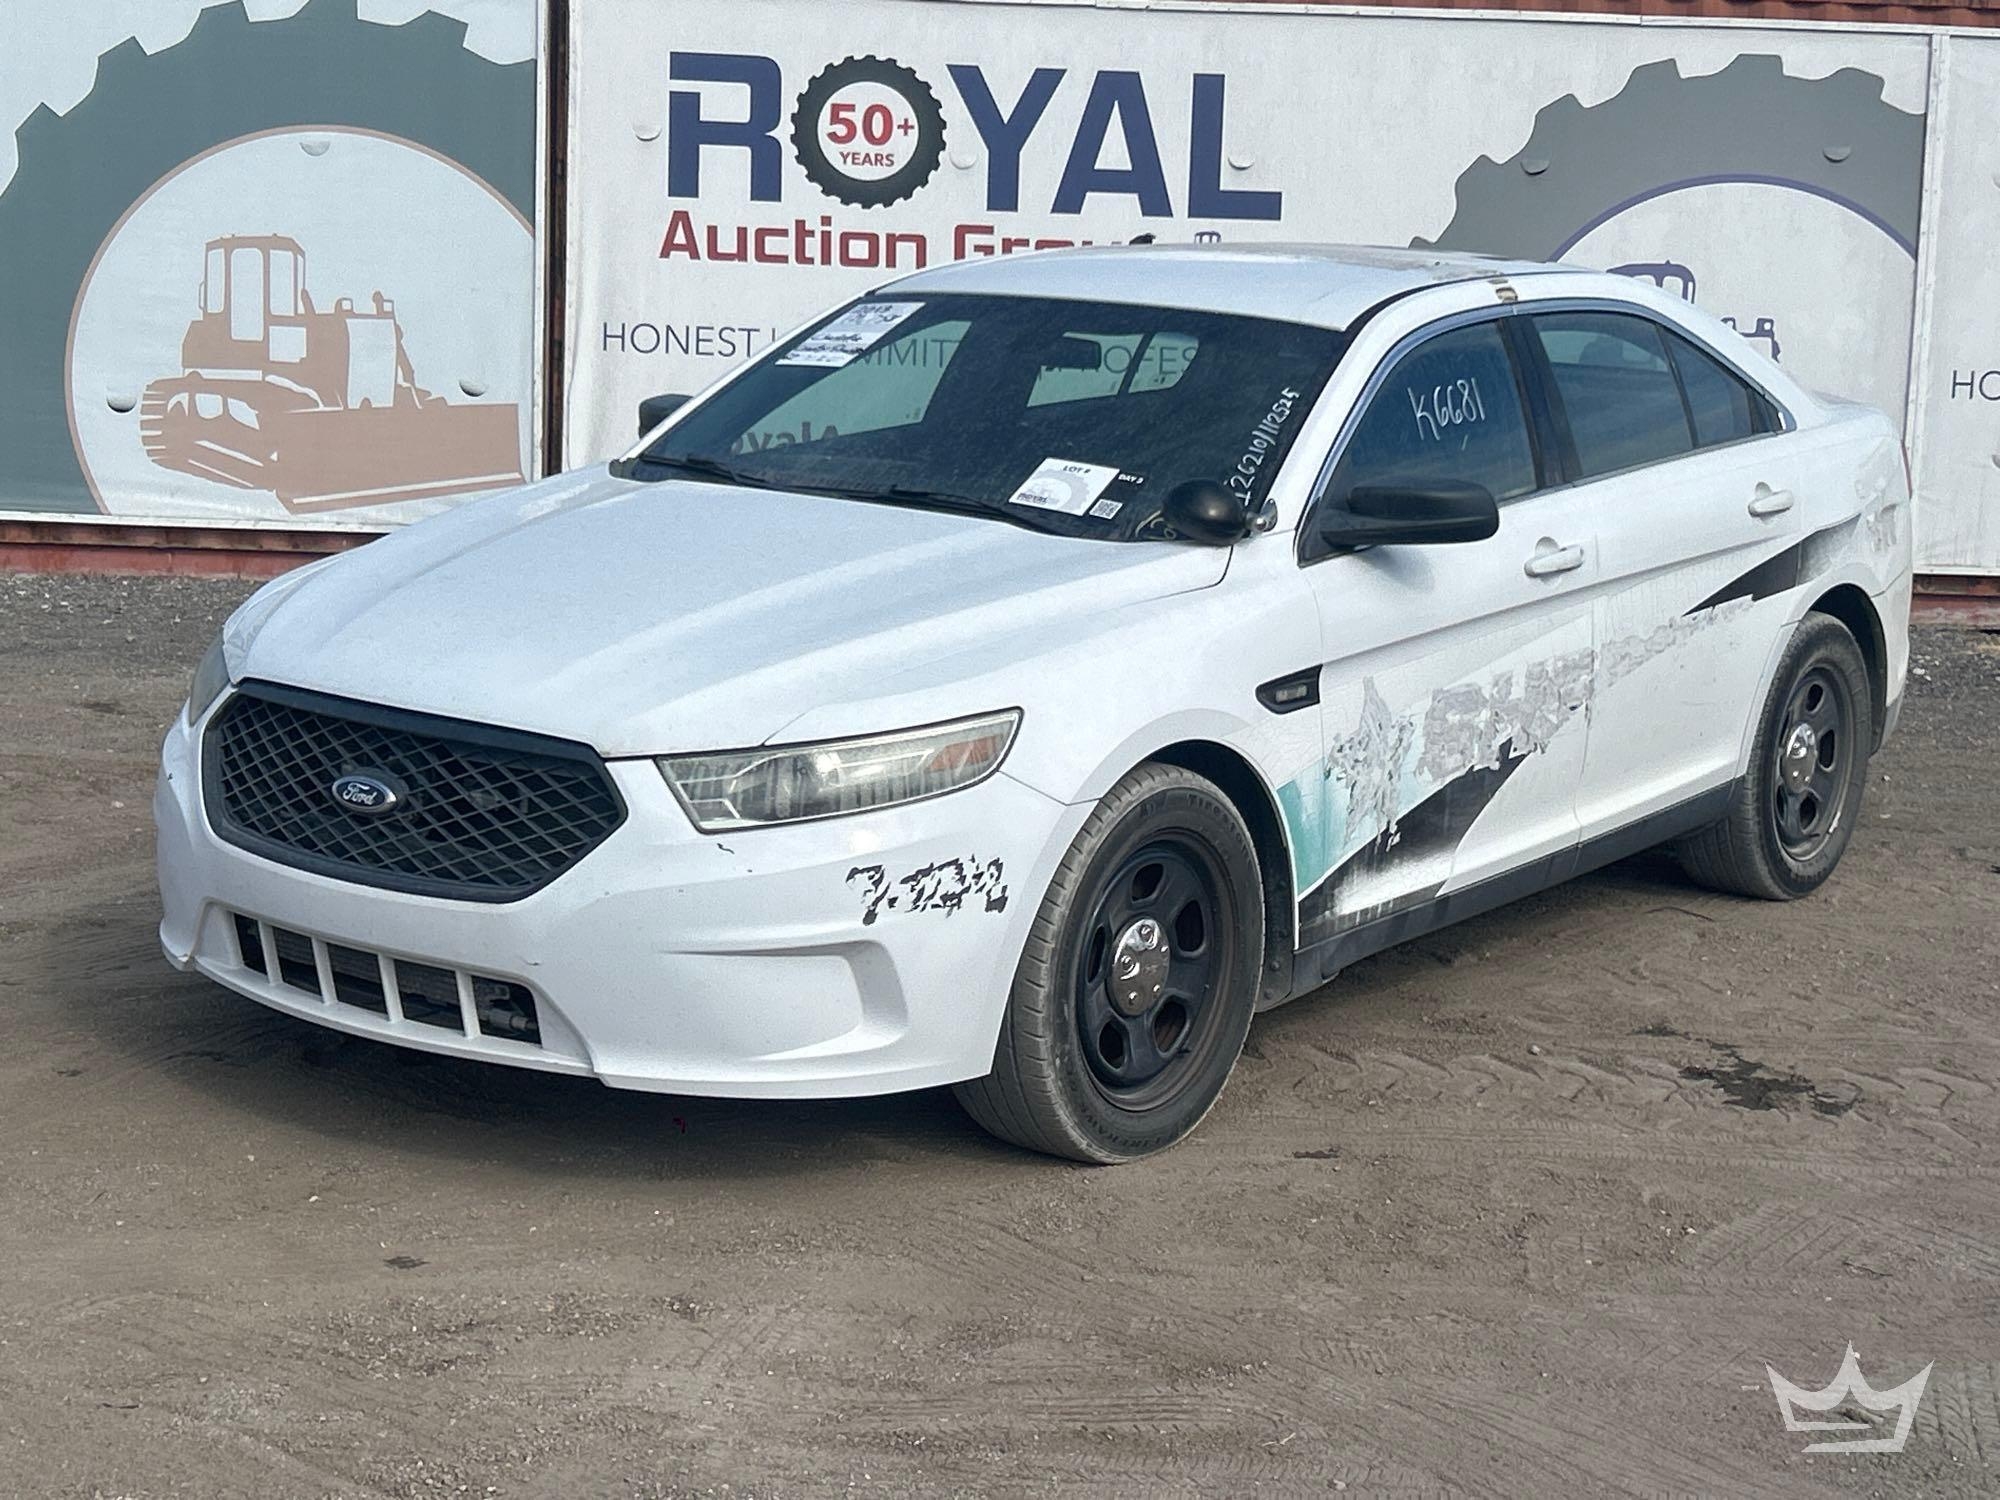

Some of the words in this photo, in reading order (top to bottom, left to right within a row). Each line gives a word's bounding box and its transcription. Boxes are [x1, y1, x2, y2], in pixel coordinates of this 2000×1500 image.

[827, 103, 915, 146] 50+
[840, 151, 895, 168] YEARS
[660, 210, 927, 269] Auction
[603, 322, 760, 358] HONEST
[1407, 377, 1485, 440] K6681
[1063, 465, 1083, 474] LOT
[342, 782, 378, 805] Ford
